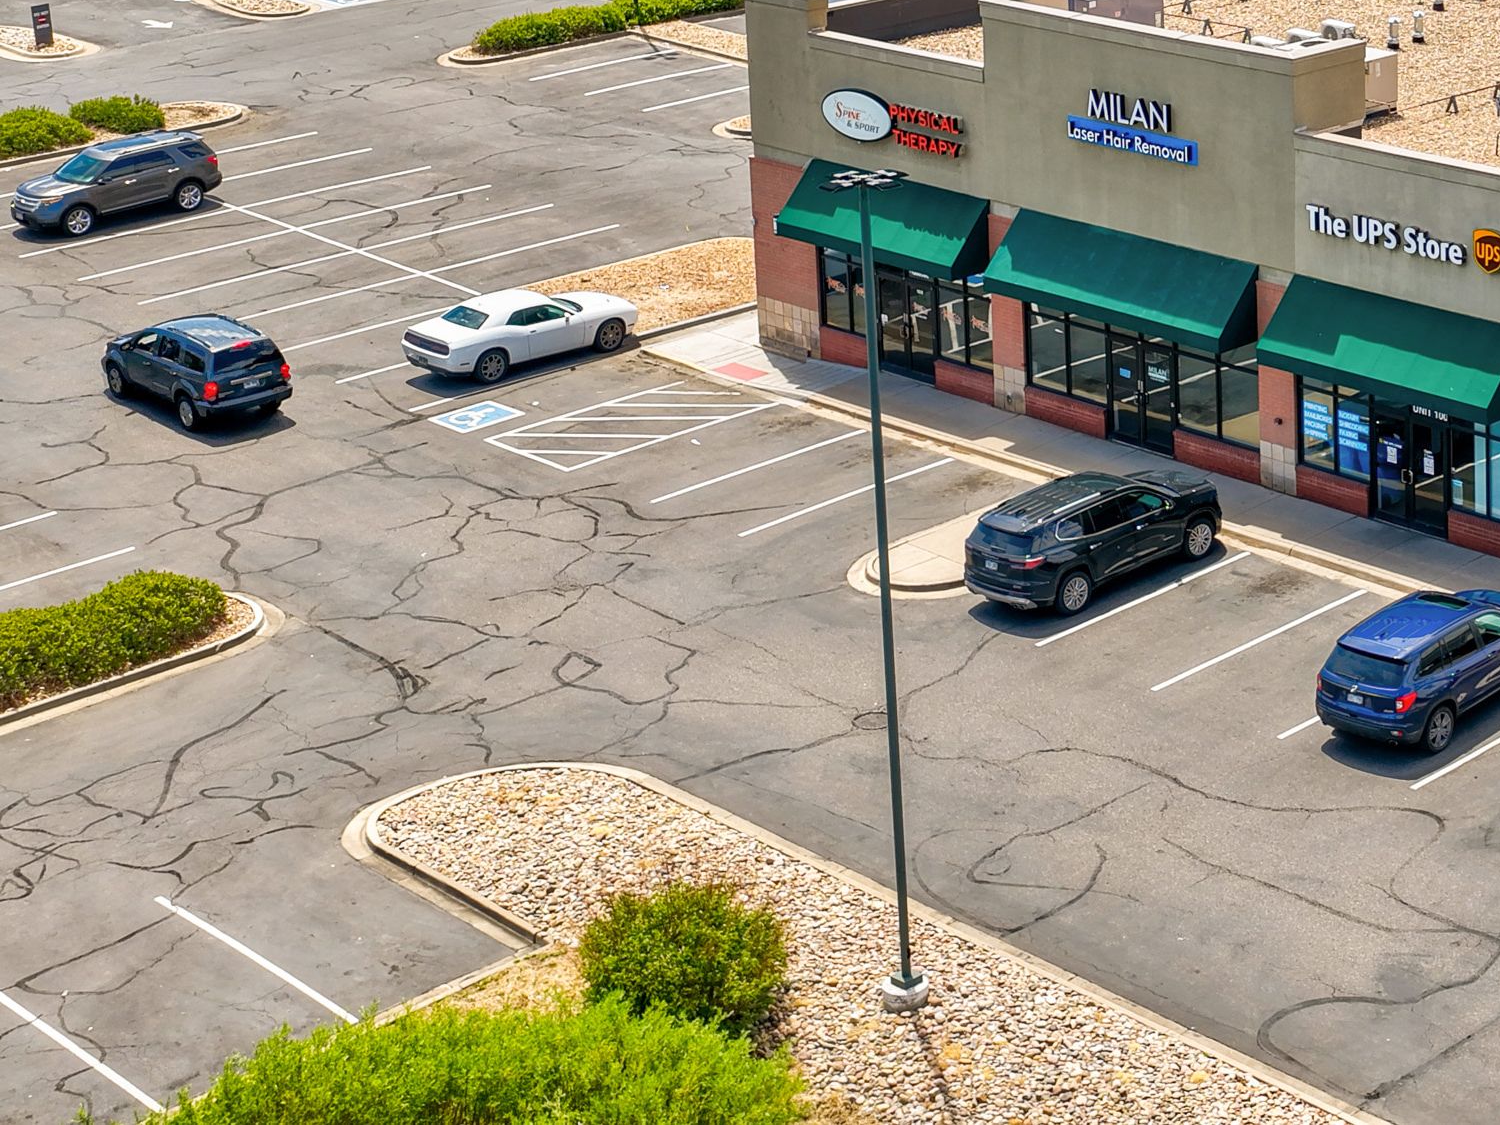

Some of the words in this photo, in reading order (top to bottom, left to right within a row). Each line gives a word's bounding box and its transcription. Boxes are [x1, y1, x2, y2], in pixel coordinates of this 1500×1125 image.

[846, 120, 853, 129] &
[854, 121, 881, 134] SPORT
[888, 103, 960, 135] PHYSICAL
[1087, 88, 1169, 134] MILAN
[891, 128, 959, 159] THERAPY
[1067, 120, 1100, 143] Laser
[1103, 129, 1131, 150] Hair
[1134, 135, 1189, 163] Removal
[1305, 203, 1348, 238] The
[1352, 214, 1399, 250] UPS
[1403, 226, 1464, 266] Store
[1476, 241, 1500, 267] ups
